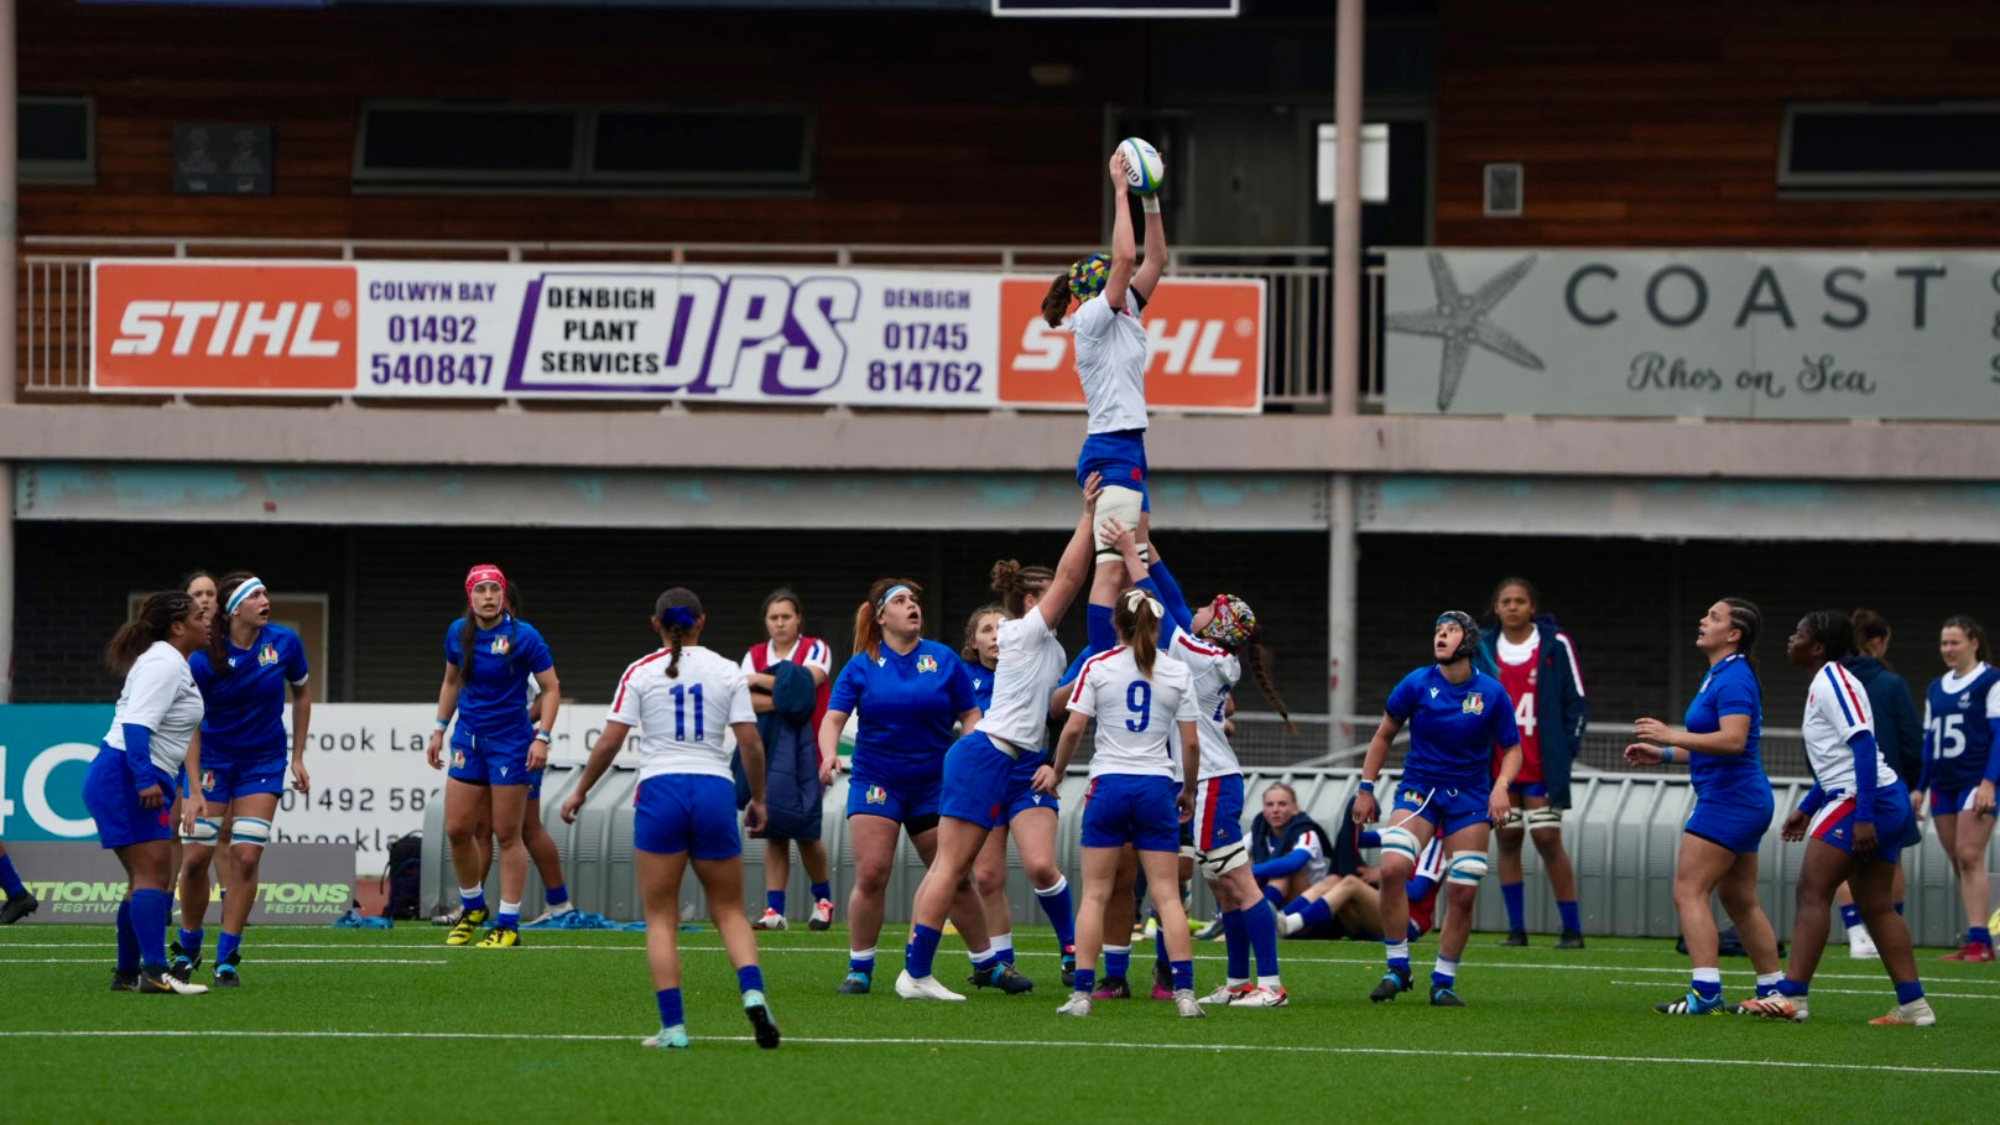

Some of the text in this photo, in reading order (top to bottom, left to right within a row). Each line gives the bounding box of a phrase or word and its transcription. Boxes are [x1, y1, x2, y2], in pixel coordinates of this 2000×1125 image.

[369, 281, 496, 302] COLWYN BAY
[547, 286, 656, 310] DENBIGH
[883, 289, 970, 310] DENBIGH
[1563, 263, 1947, 330] COAST
[111, 300, 341, 357] STIHL
[388, 315, 477, 344] 01492
[563, 320, 638, 342] PLANT
[640, 272, 861, 396] DPS
[884, 323, 968, 352] 01745
[1011, 315, 1242, 376] SHL
[371, 354, 494, 386] 540847
[541, 352, 660, 375] SERVICES
[867, 361, 983, 393] 814762
[1626, 352, 1876, 398] Rhos on Sea
[668, 683, 704, 741] 11
[1125, 680, 1152, 733] 9
[1514, 692, 1537, 736] 4
[1931, 714, 1966, 760] 15
[280, 788, 374, 811] 01492
[52, 903, 121, 913] FESTIVA
[265, 904, 344, 914] FESTIVAL
